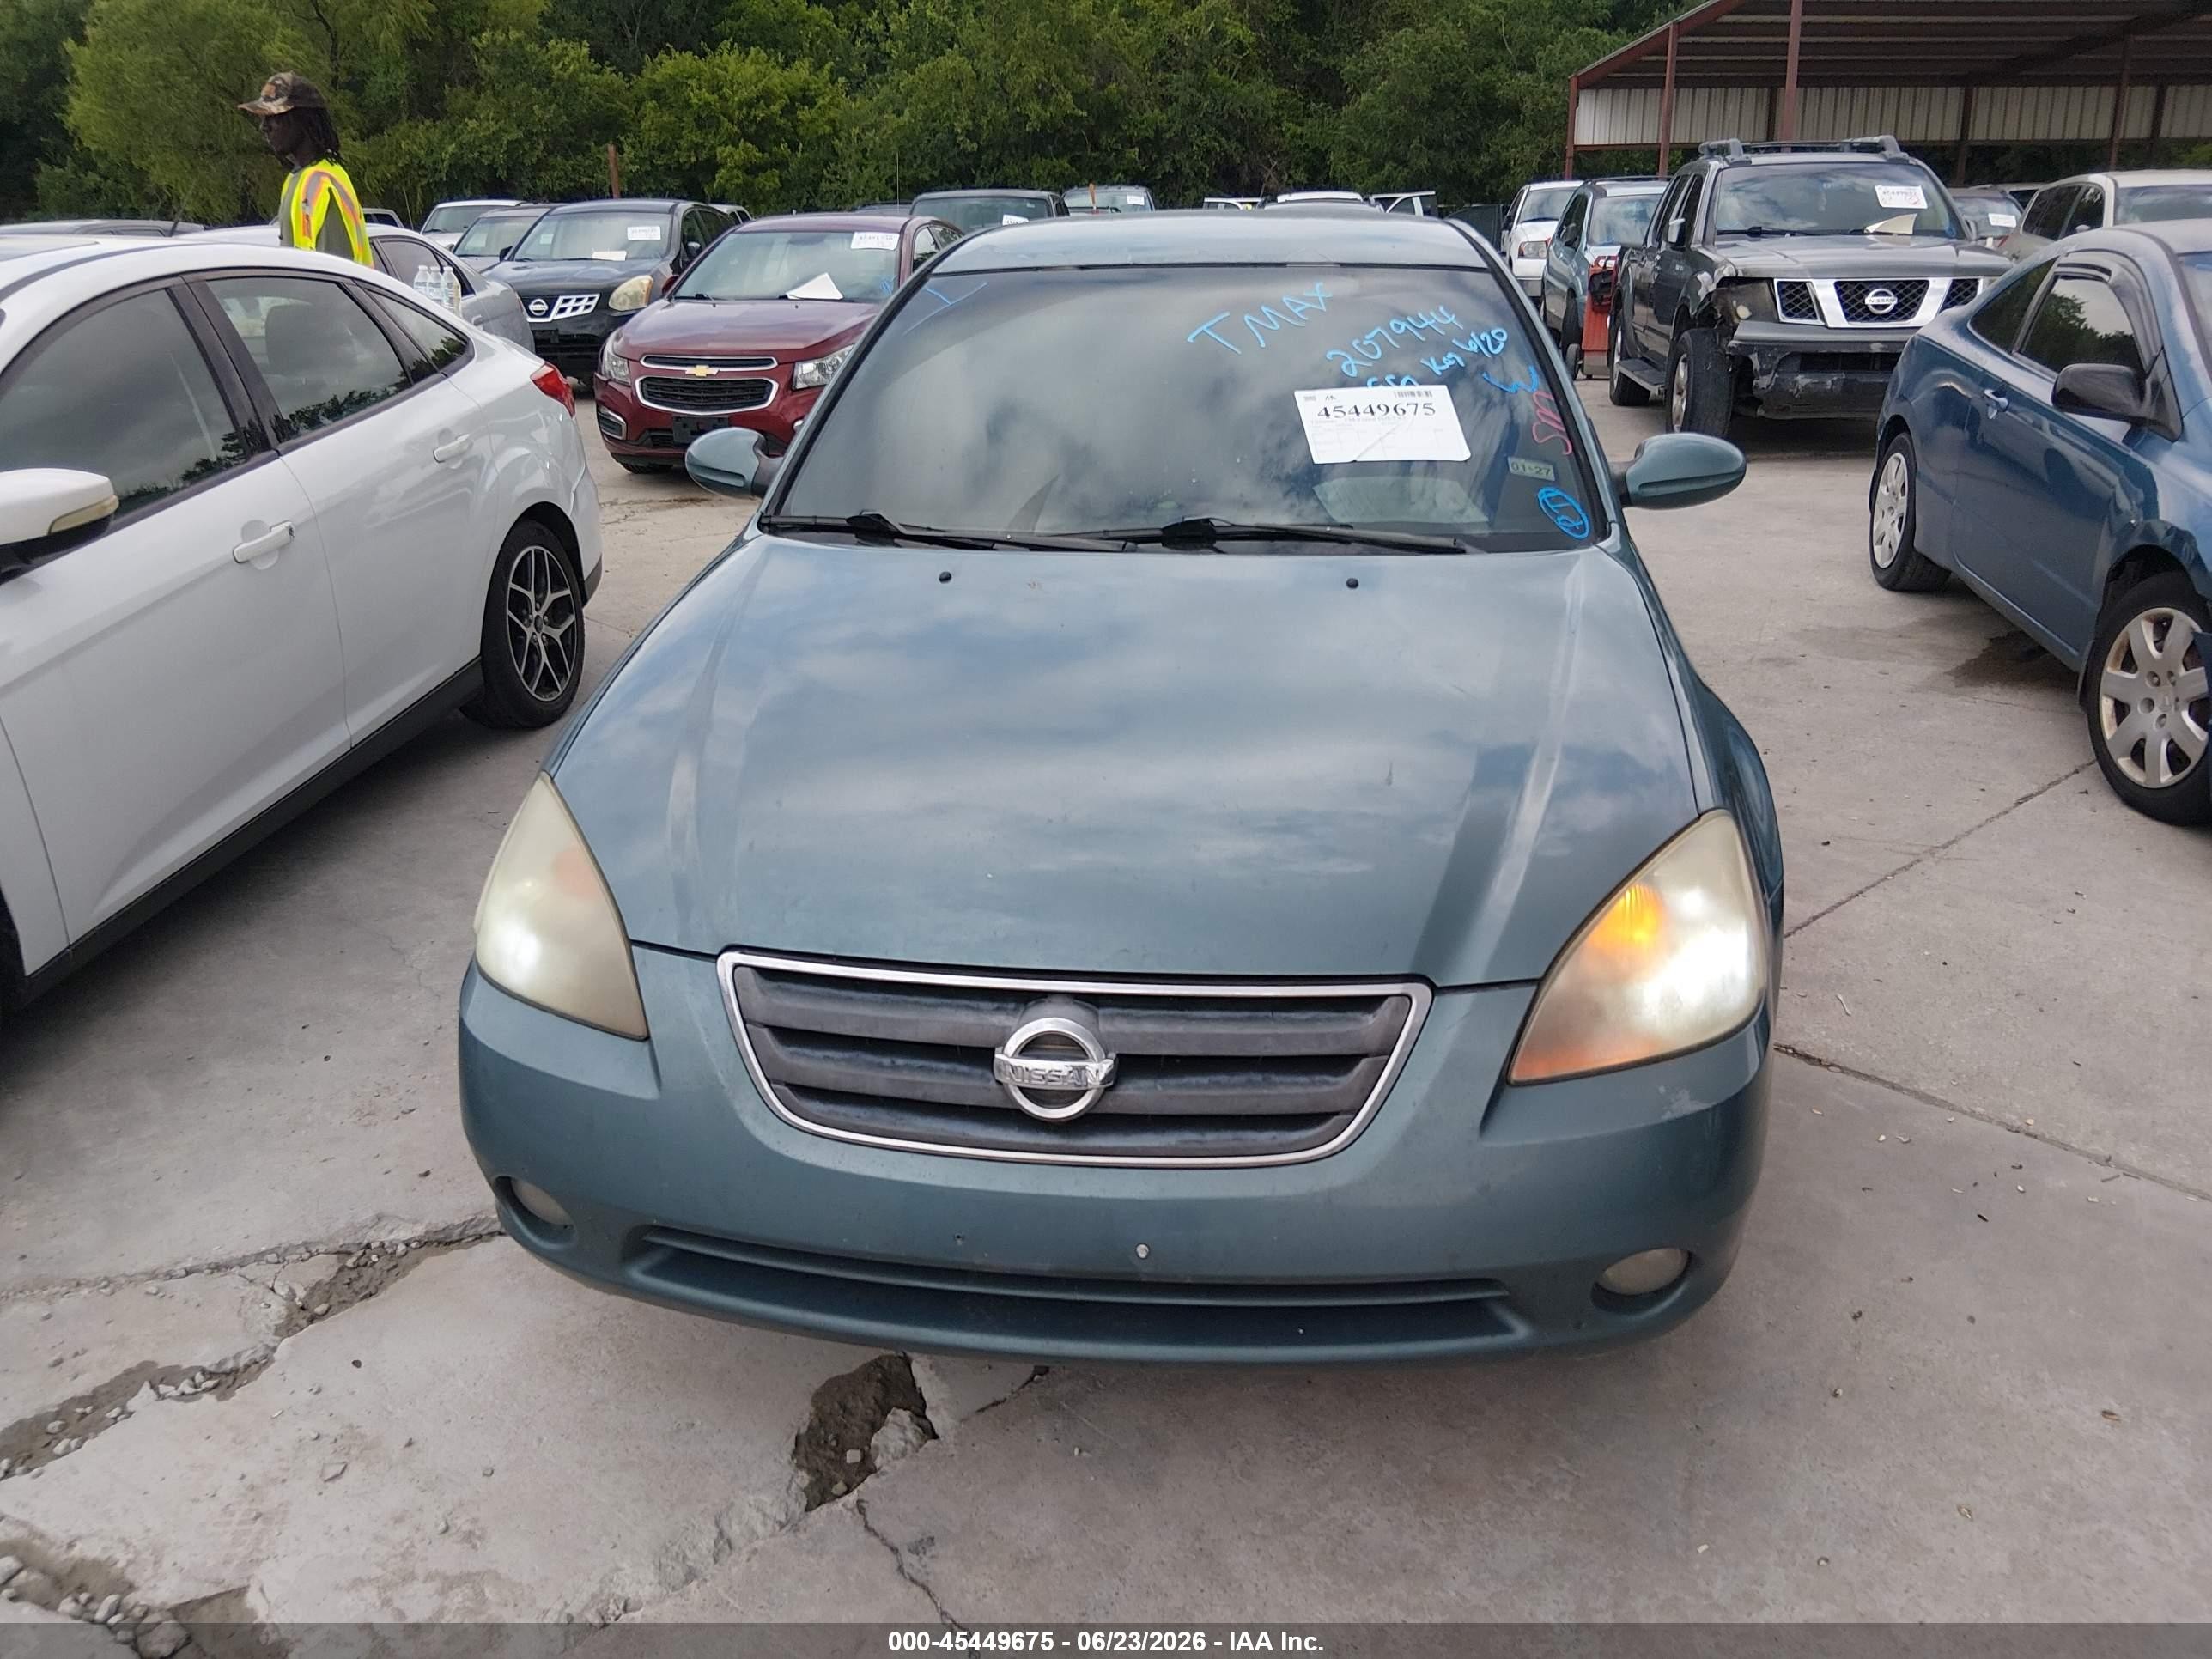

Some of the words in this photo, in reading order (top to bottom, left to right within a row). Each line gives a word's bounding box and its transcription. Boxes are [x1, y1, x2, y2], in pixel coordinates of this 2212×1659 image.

[1327, 305, 1463, 377] 207944
[1317, 402, 1437, 420] 45449675
[1001, 1062, 1102, 1088] NISSAN
